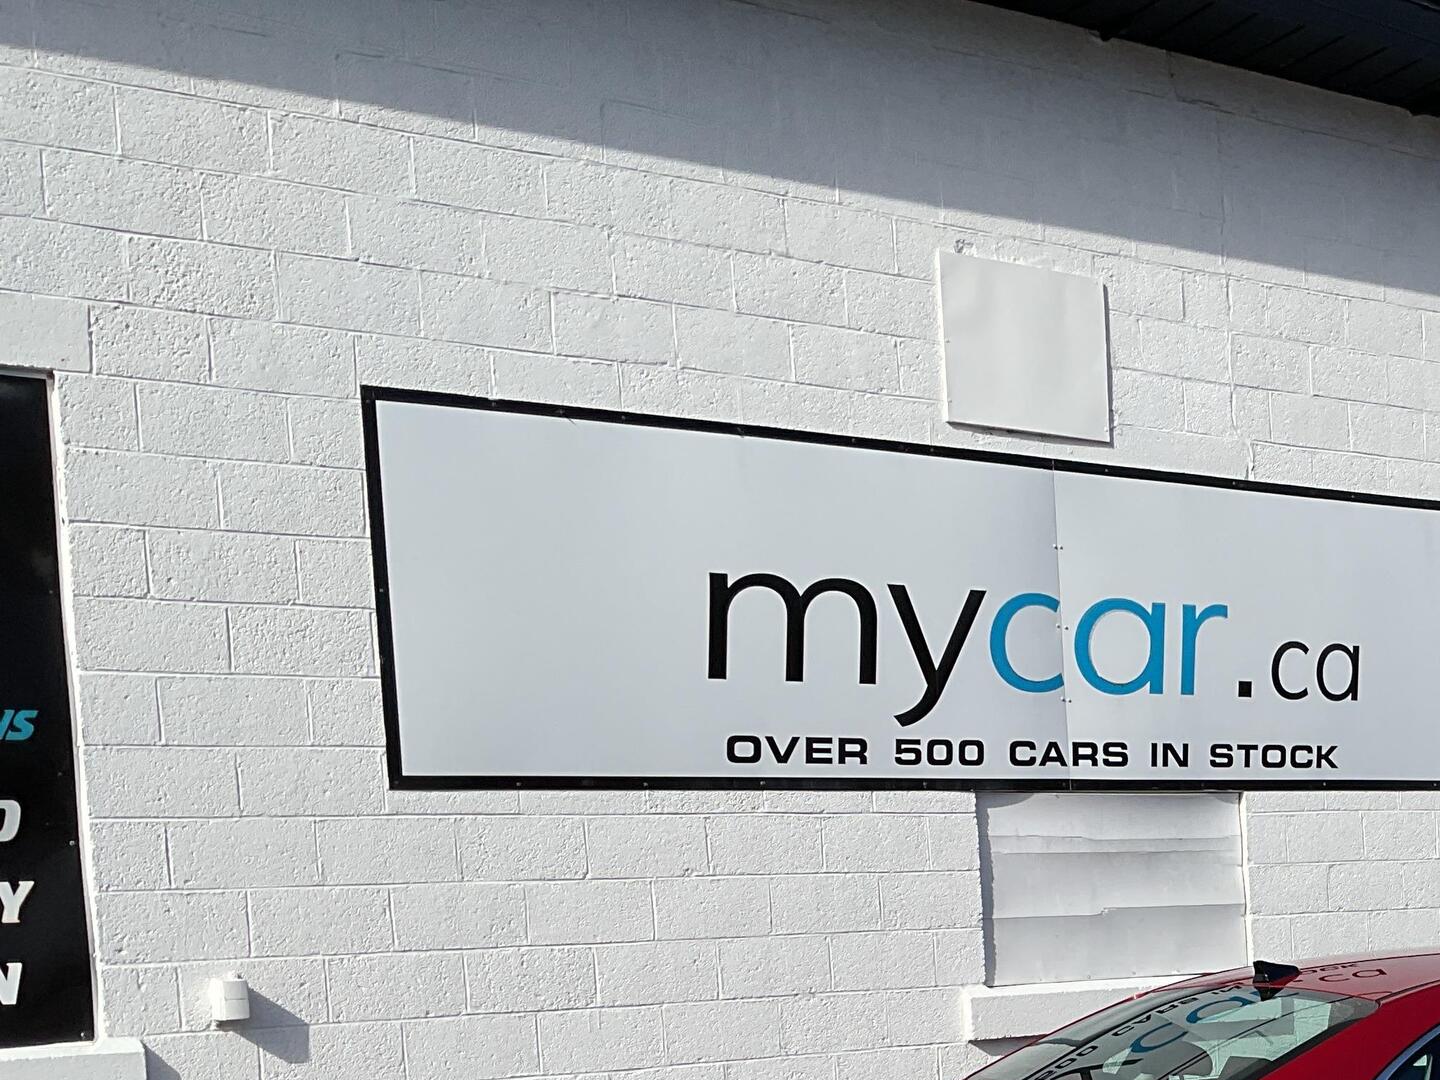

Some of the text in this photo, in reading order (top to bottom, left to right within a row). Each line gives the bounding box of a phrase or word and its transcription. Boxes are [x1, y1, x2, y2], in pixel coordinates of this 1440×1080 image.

[726, 735, 1339, 769] OVER 500 CARS IN STOCK
